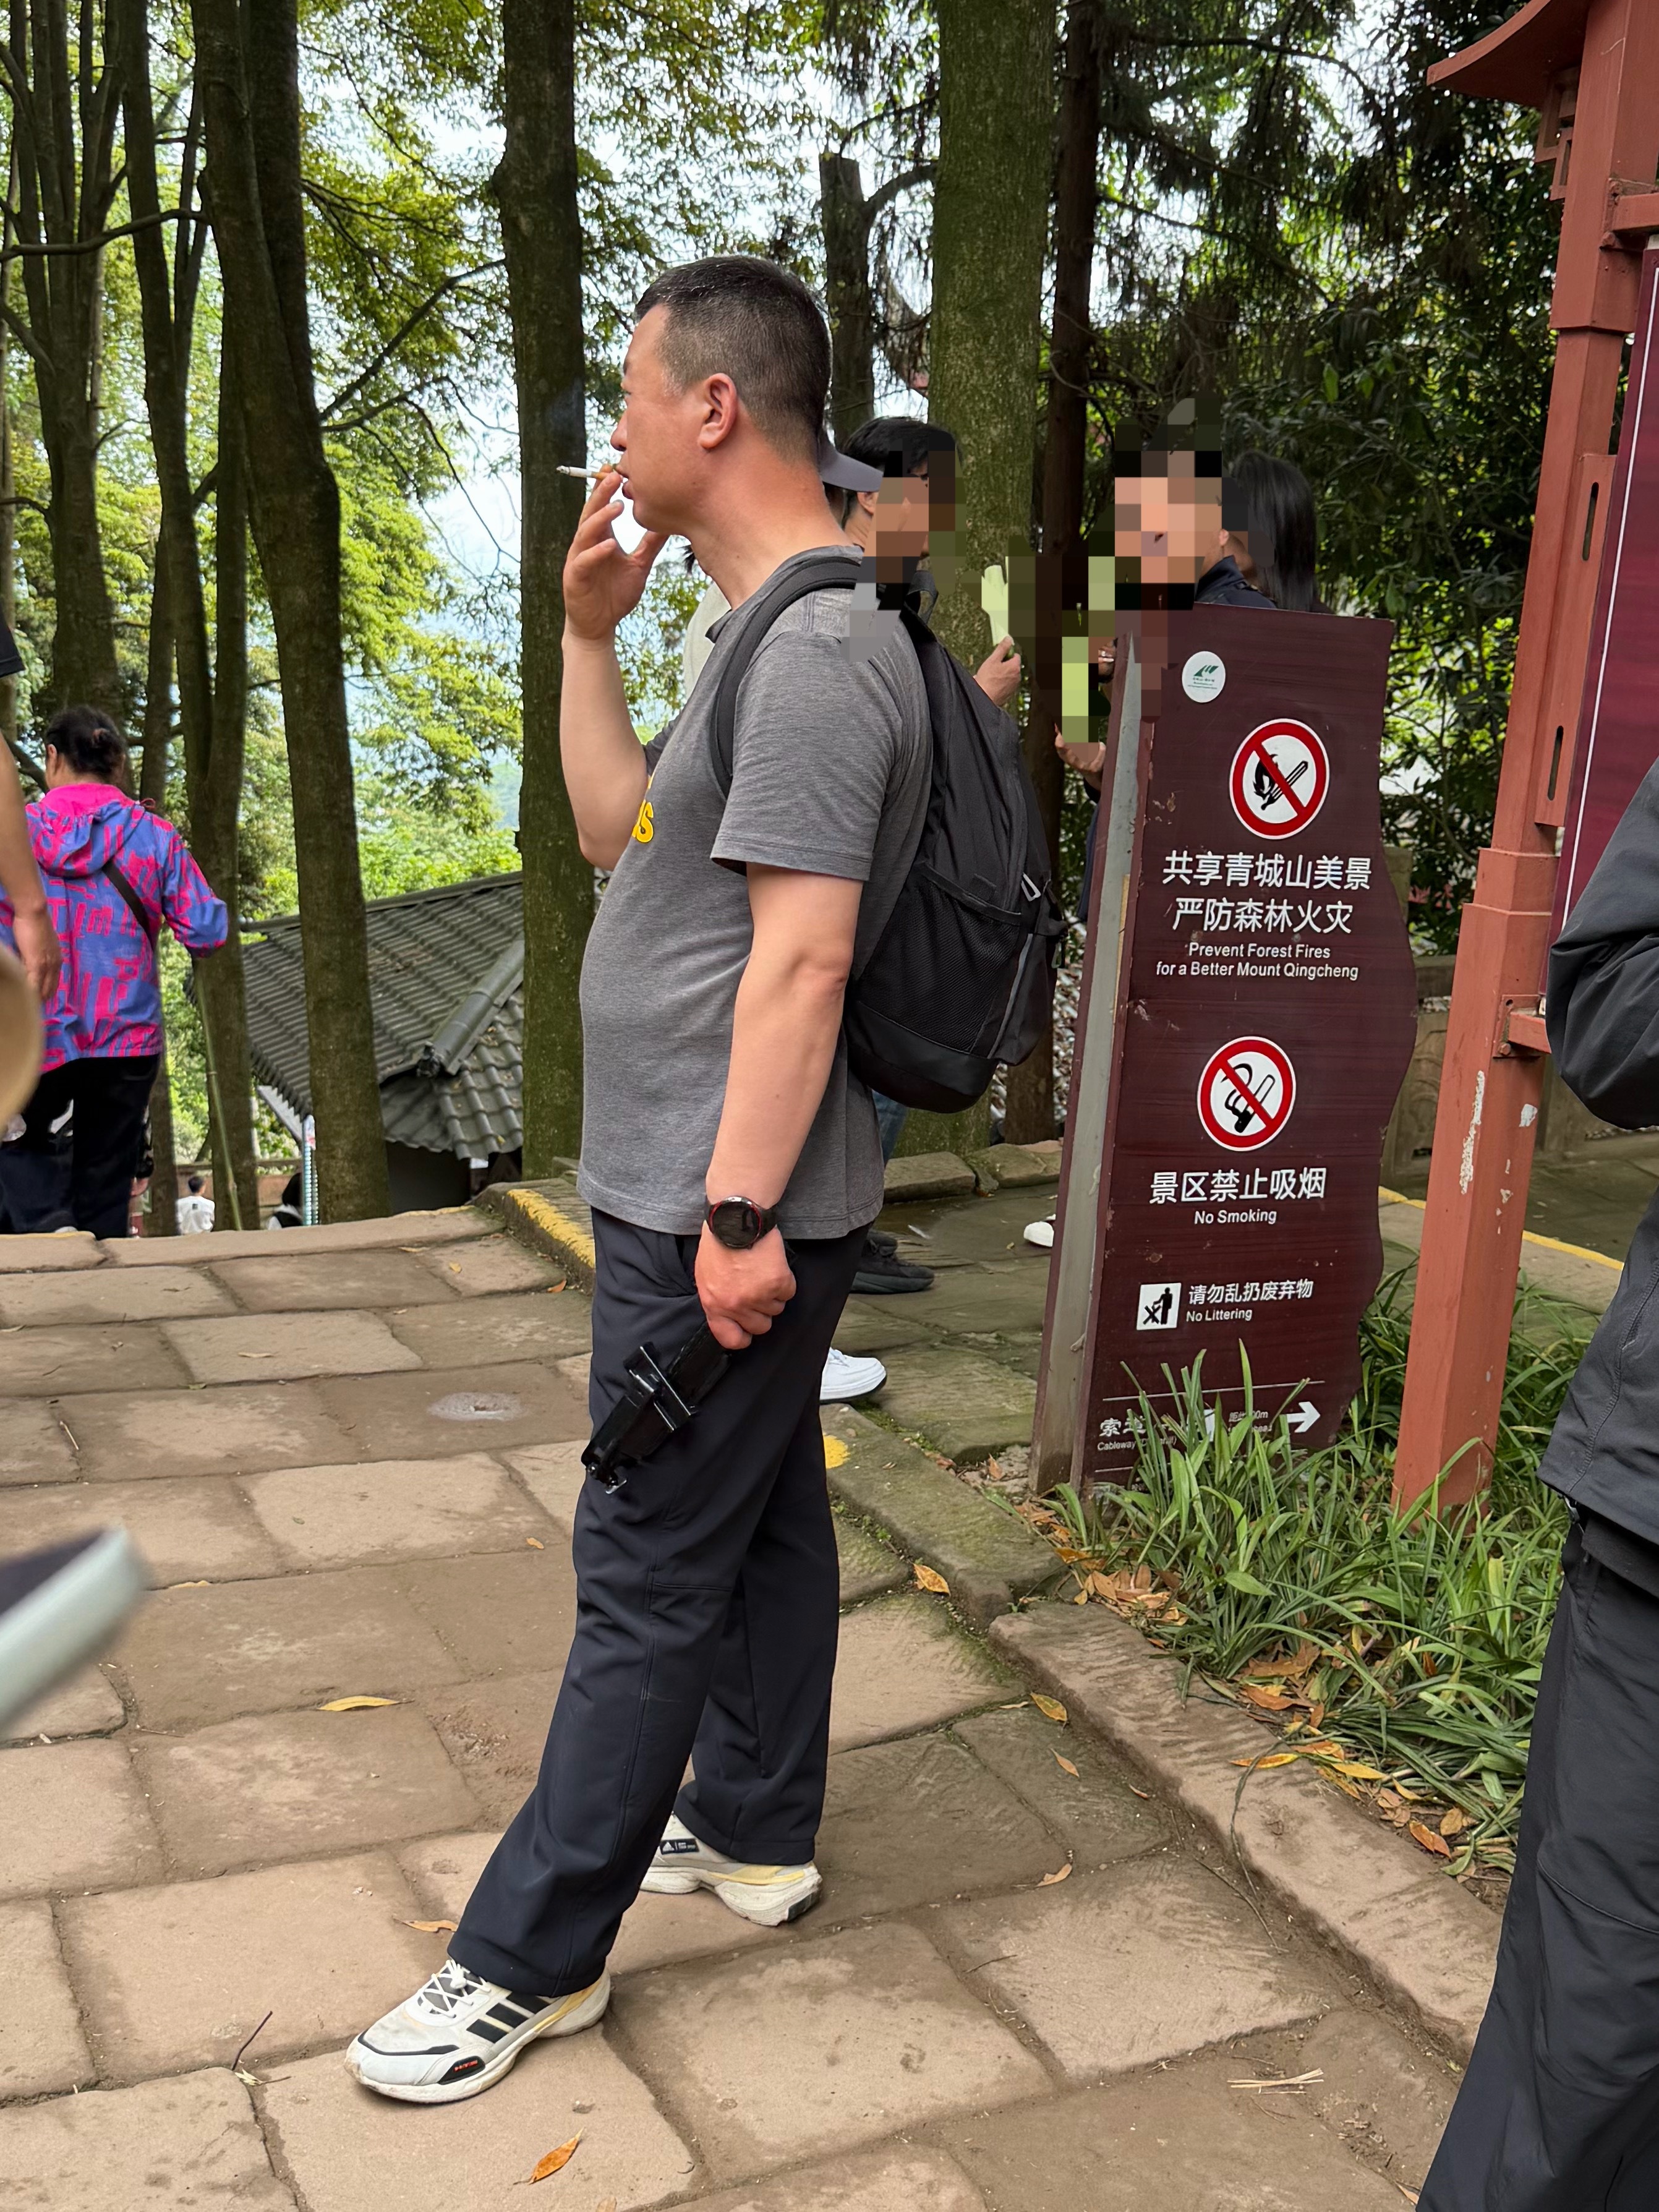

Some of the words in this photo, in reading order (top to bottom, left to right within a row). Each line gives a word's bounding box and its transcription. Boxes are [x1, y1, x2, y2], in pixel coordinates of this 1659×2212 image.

[1162, 850, 1371, 890] 共享青城山美景
[1172, 897, 1353, 934] 严防森林火灾
[1188, 942, 1244, 957] Prevent
[1248, 943, 1292, 958] Forest
[1295, 944, 1331, 959] Fires
[1156, 962, 1176, 976] for
[1179, 965, 1187, 976] a
[1190, 963, 1234, 976] Better
[1237, 963, 1281, 977] Mount
[1284, 963, 1358, 981] Qingcheng
[1149, 1168, 1327, 1205] 景区禁止吸烟
[1194, 1211, 1214, 1224] No
[1217, 1209, 1277, 1224] Smoking
[1188, 1279, 1313, 1305] 请勿乱扔废弃物
[1186, 1310, 1202, 1322] No
[1205, 1308, 1253, 1322] Littering
